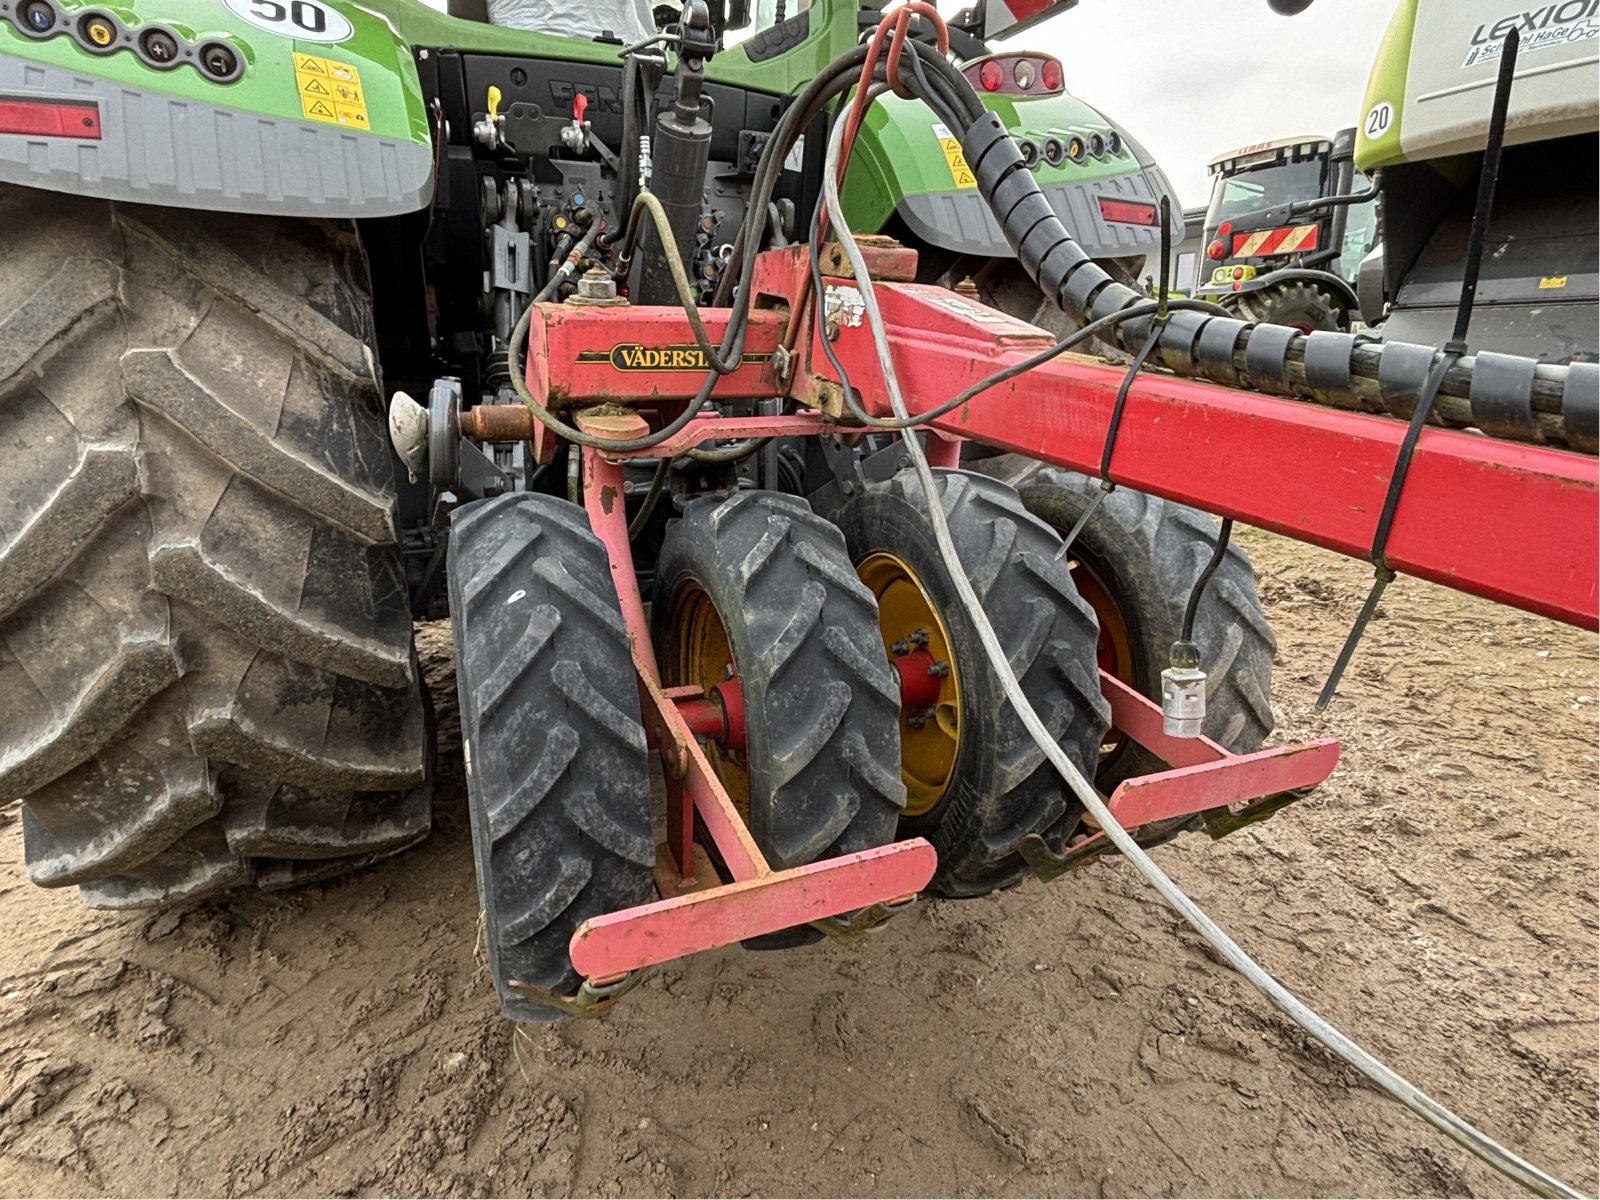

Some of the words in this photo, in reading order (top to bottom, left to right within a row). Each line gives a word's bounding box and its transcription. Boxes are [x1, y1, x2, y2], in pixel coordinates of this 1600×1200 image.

[250, 0, 326, 32] 50
[1534, 26, 1570, 43] HaGe
[1368, 105, 1389, 134] 20
[621, 346, 715, 368] VÄDERST
